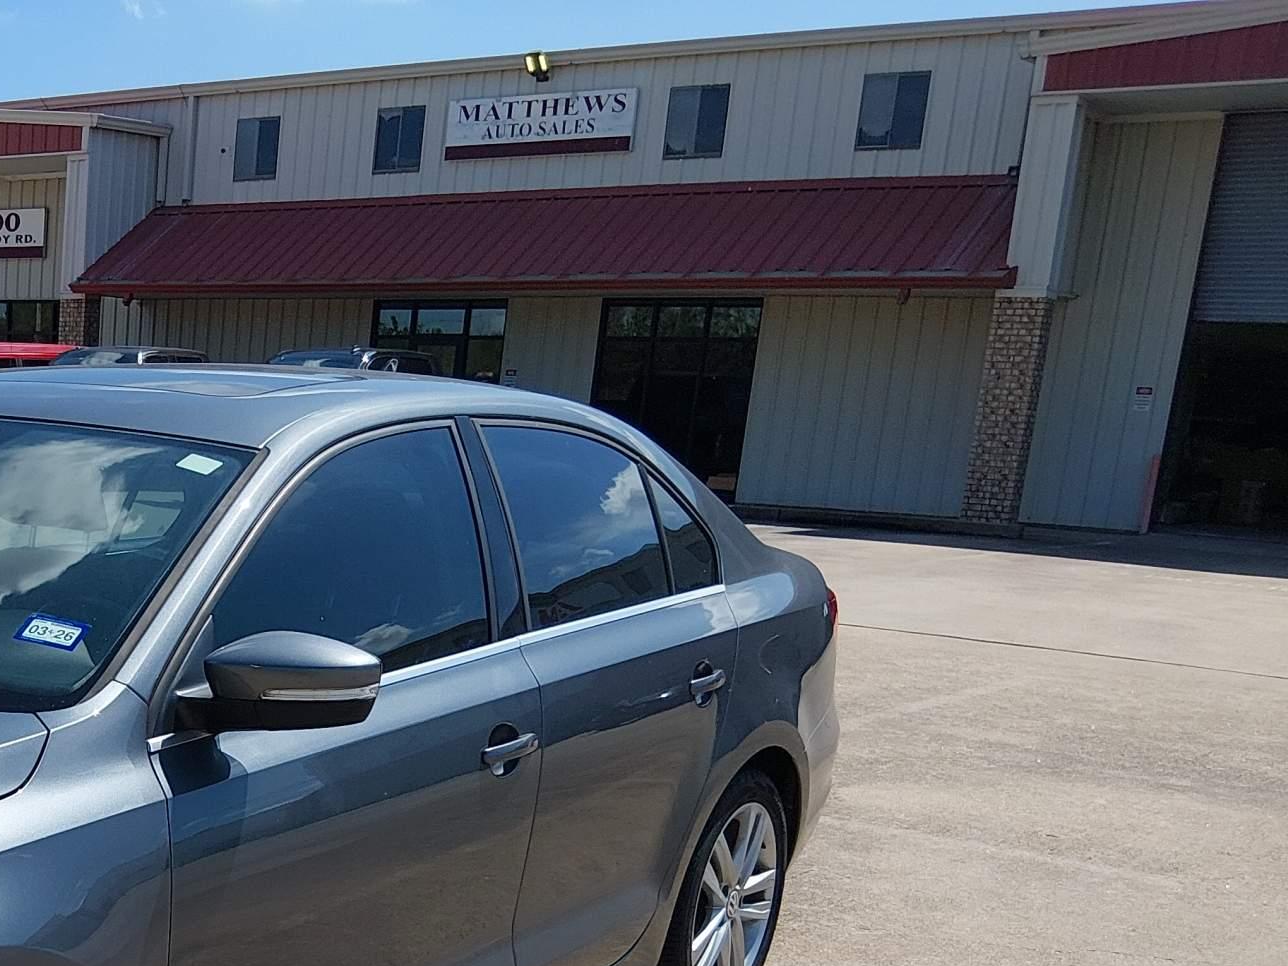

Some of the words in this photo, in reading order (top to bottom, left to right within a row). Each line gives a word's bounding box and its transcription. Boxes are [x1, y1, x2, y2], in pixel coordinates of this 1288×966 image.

[458, 92, 627, 124] MATTHEWS
[481, 122, 533, 140] AUTO
[535, 117, 597, 137] SALES
[15, 234, 36, 243] RD.
